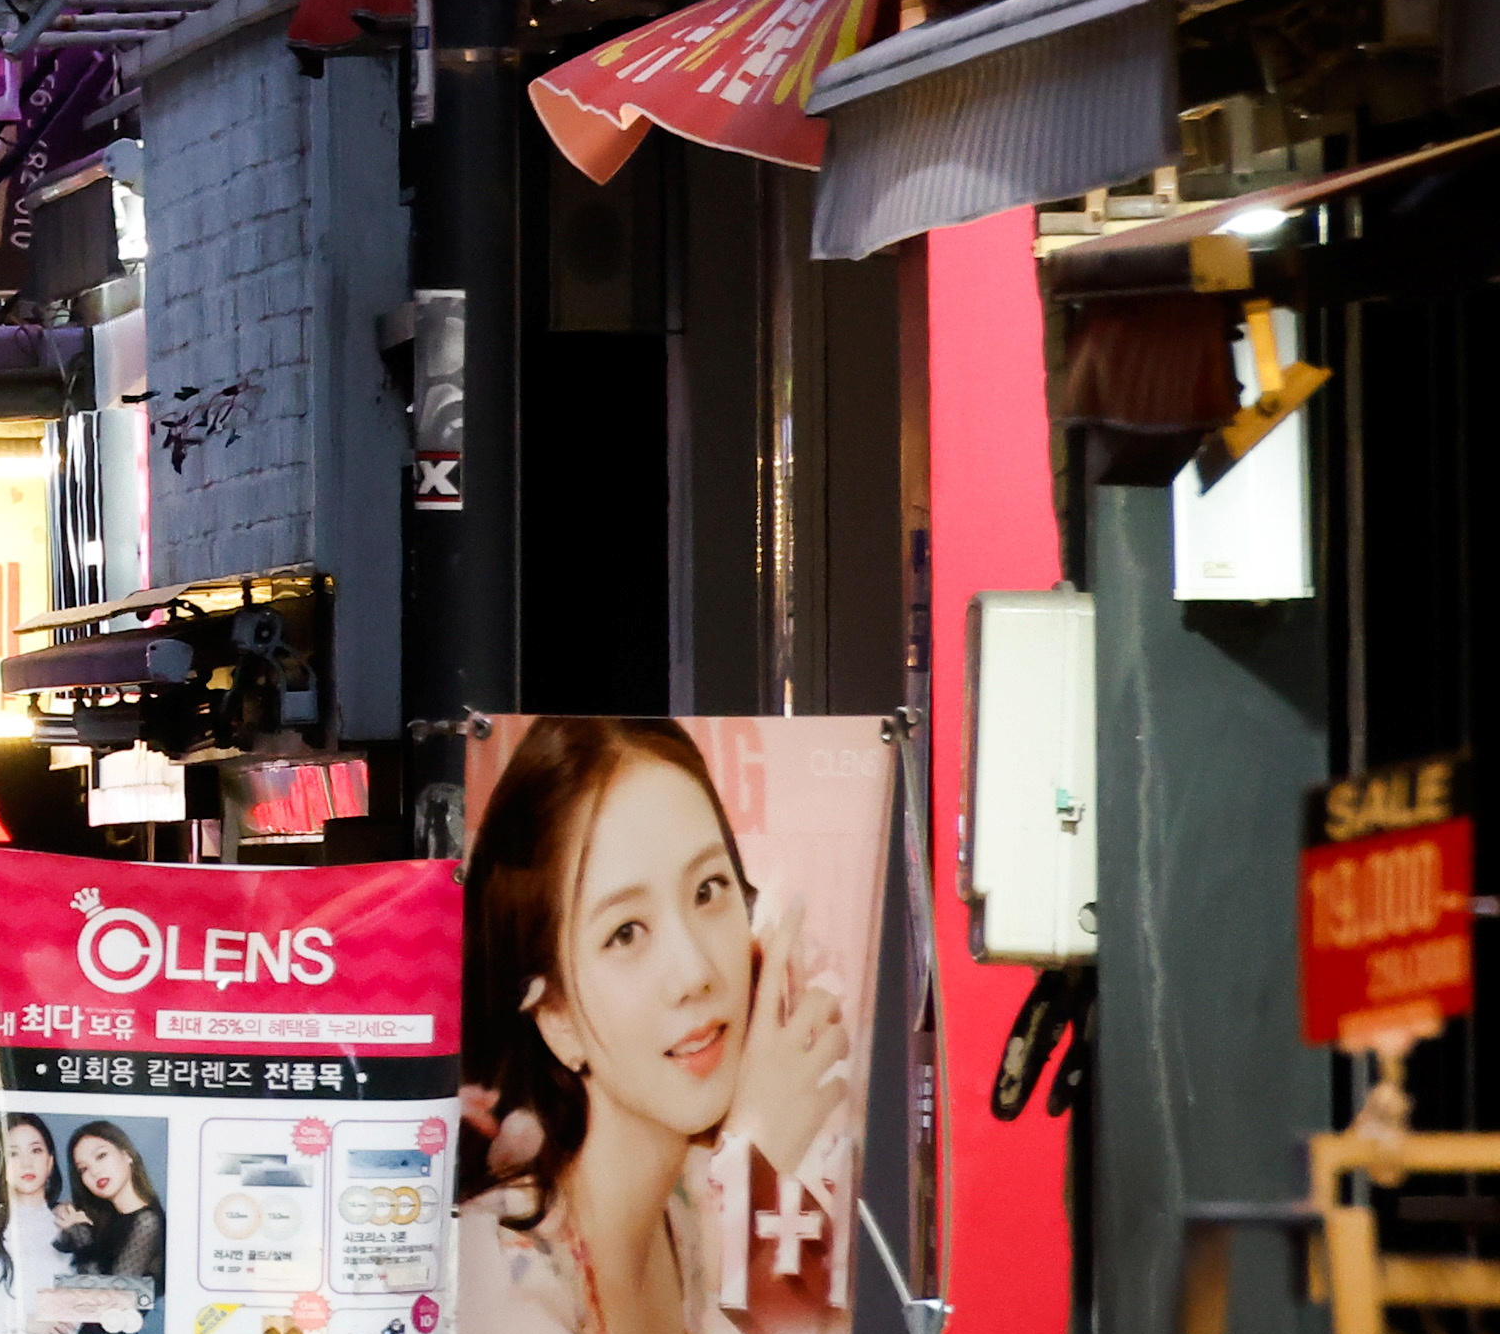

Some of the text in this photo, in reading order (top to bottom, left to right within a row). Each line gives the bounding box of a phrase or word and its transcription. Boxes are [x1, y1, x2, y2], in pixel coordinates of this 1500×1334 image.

[1324, 760, 1454, 843] SALE
[21, 1002, 85, 1039] 최다
[90, 1013, 137, 1042] 보유
[167, 1015, 203, 1035] 최대
[56, 1056, 346, 1093] 일회용 칼라렌즈 전품목
